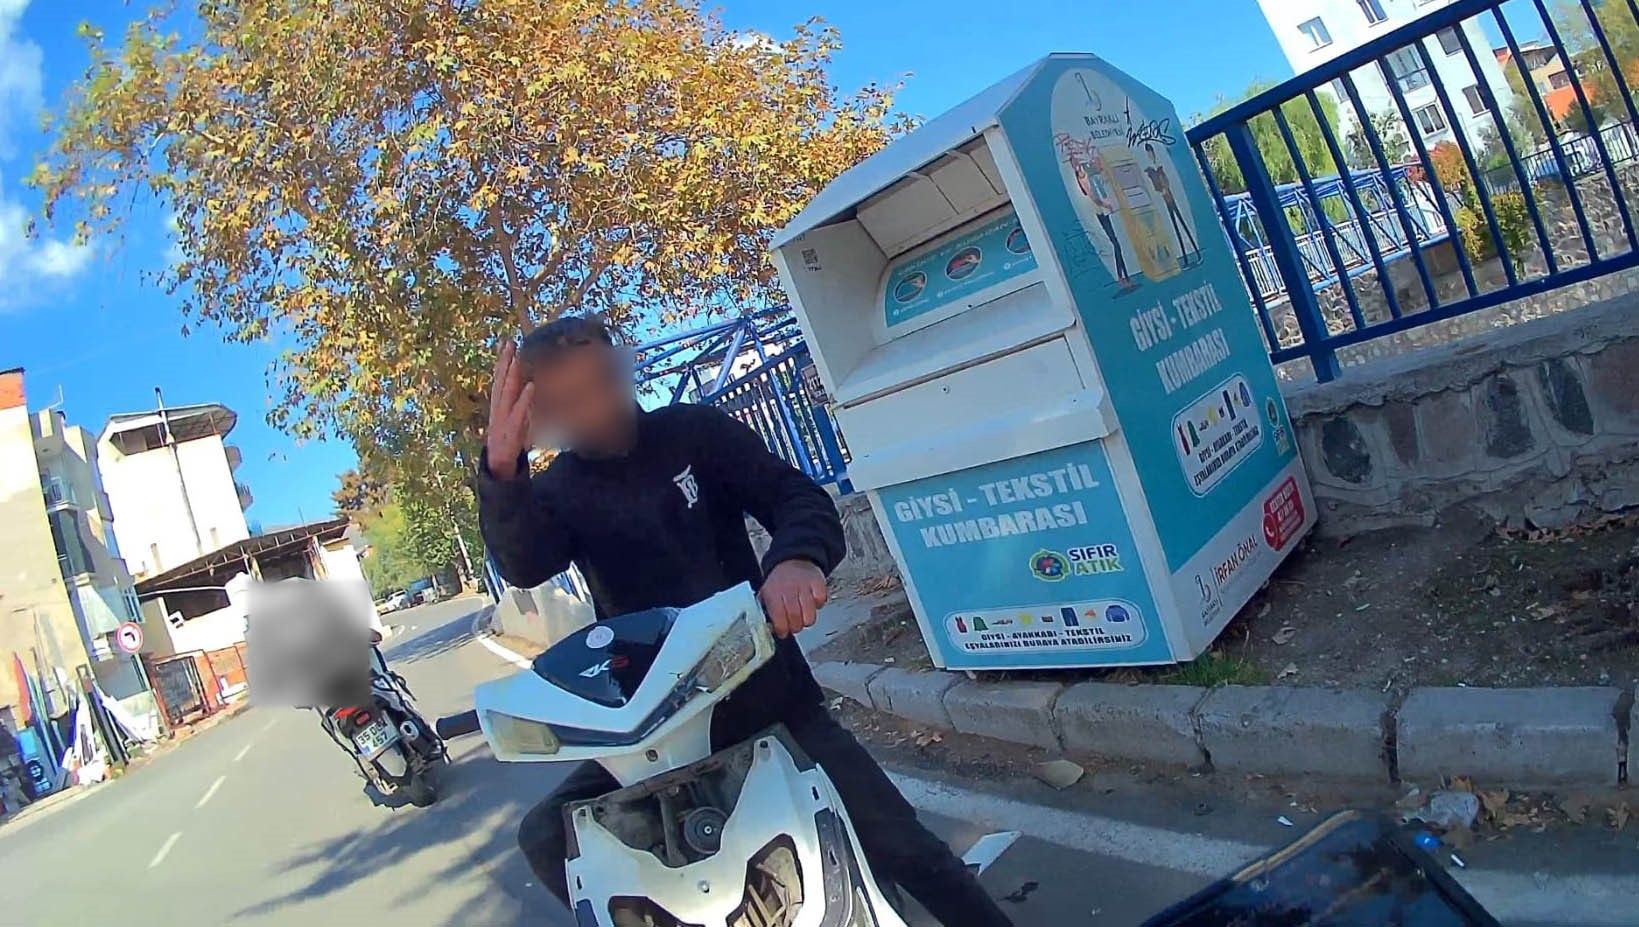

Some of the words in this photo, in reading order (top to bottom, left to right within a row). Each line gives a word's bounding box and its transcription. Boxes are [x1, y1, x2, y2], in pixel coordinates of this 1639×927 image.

[1129, 301, 1173, 351] GİYSİ
[1173, 280, 1223, 329] TEKSTİL
[1155, 328, 1230, 394] KUMBARASI
[894, 488, 963, 522] GİYSİ
[978, 463, 1099, 506] TEKSTİL
[920, 501, 1088, 548] KUMBARASI
[1068, 544, 1118, 563] SIFIR
[1074, 557, 1122, 576] ATIK
[1215, 553, 1239, 587] İRFAN
[358, 731, 371, 745] 35
[372, 731, 388, 747] 457
